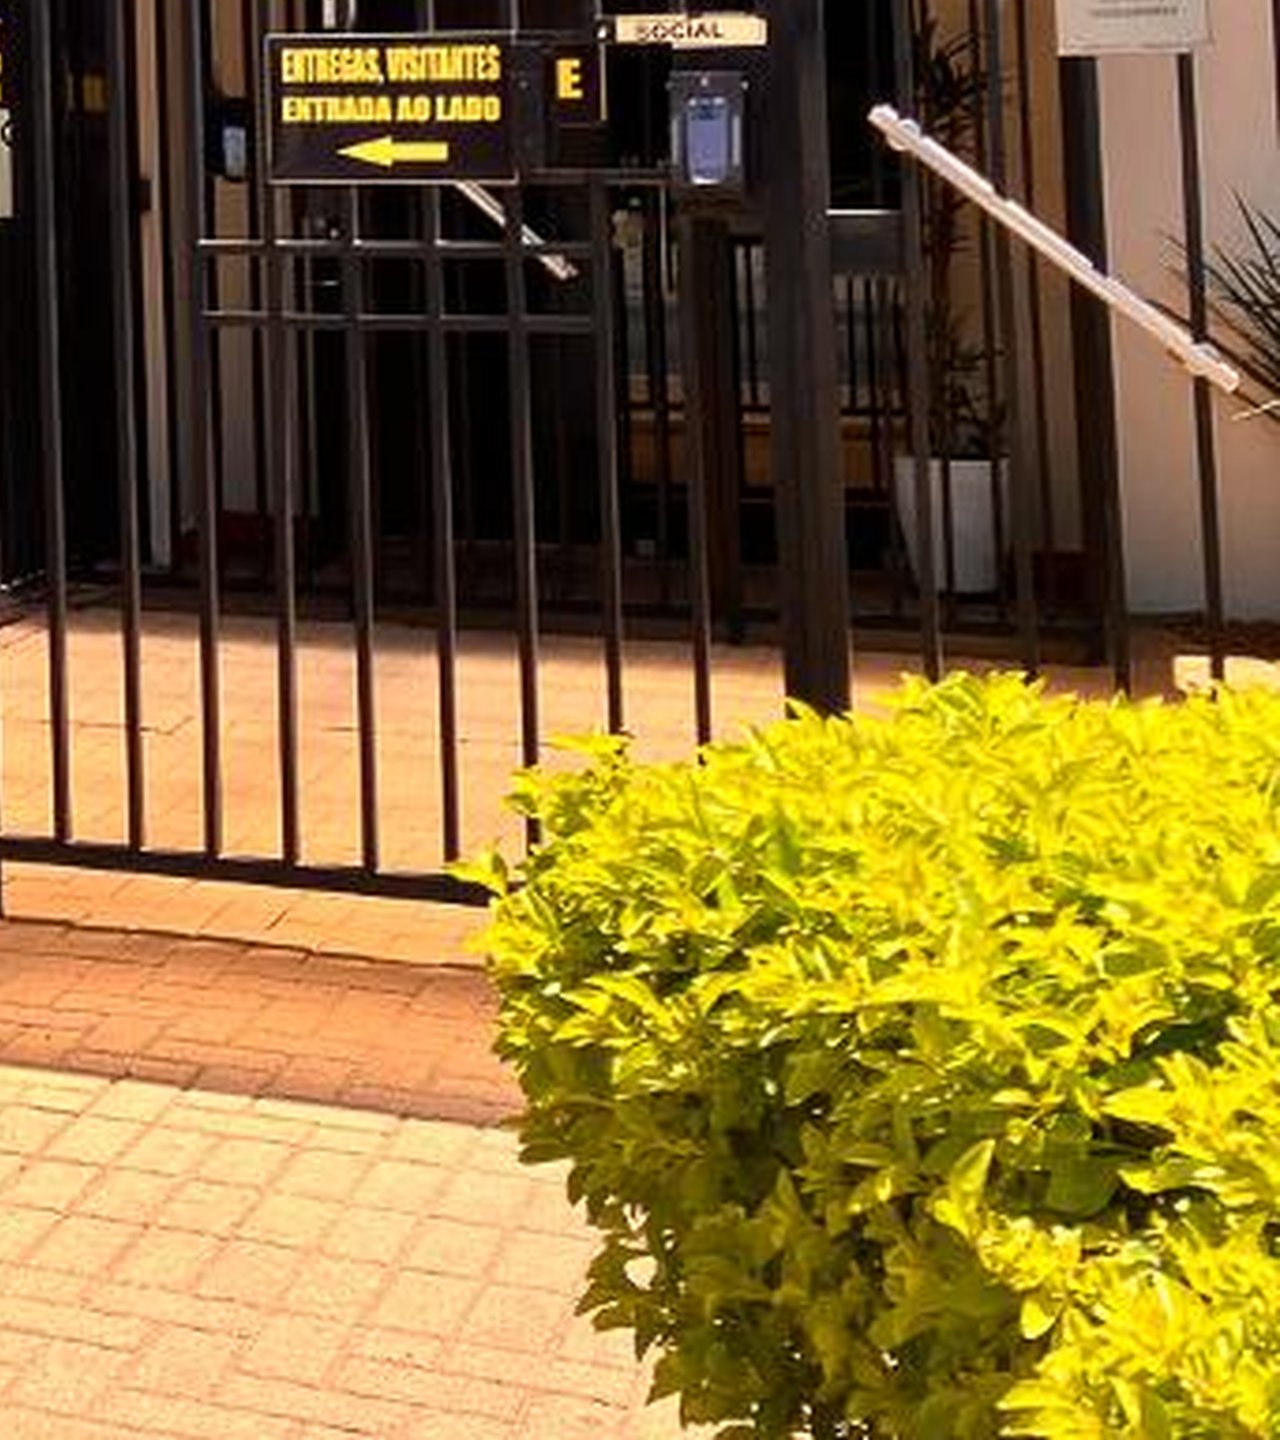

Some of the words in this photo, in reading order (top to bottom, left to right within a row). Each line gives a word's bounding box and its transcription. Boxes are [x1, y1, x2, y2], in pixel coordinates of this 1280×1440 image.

[636, 21, 724, 41] SOCIAL
[281, 47, 385, 84] ENTREGAS,
[386, 44, 501, 81] VISITANTES
[556, 58, 584, 100] E
[281, 95, 391, 122] ENTRADA
[396, 96, 431, 122] AO
[435, 95, 501, 122] LADO
